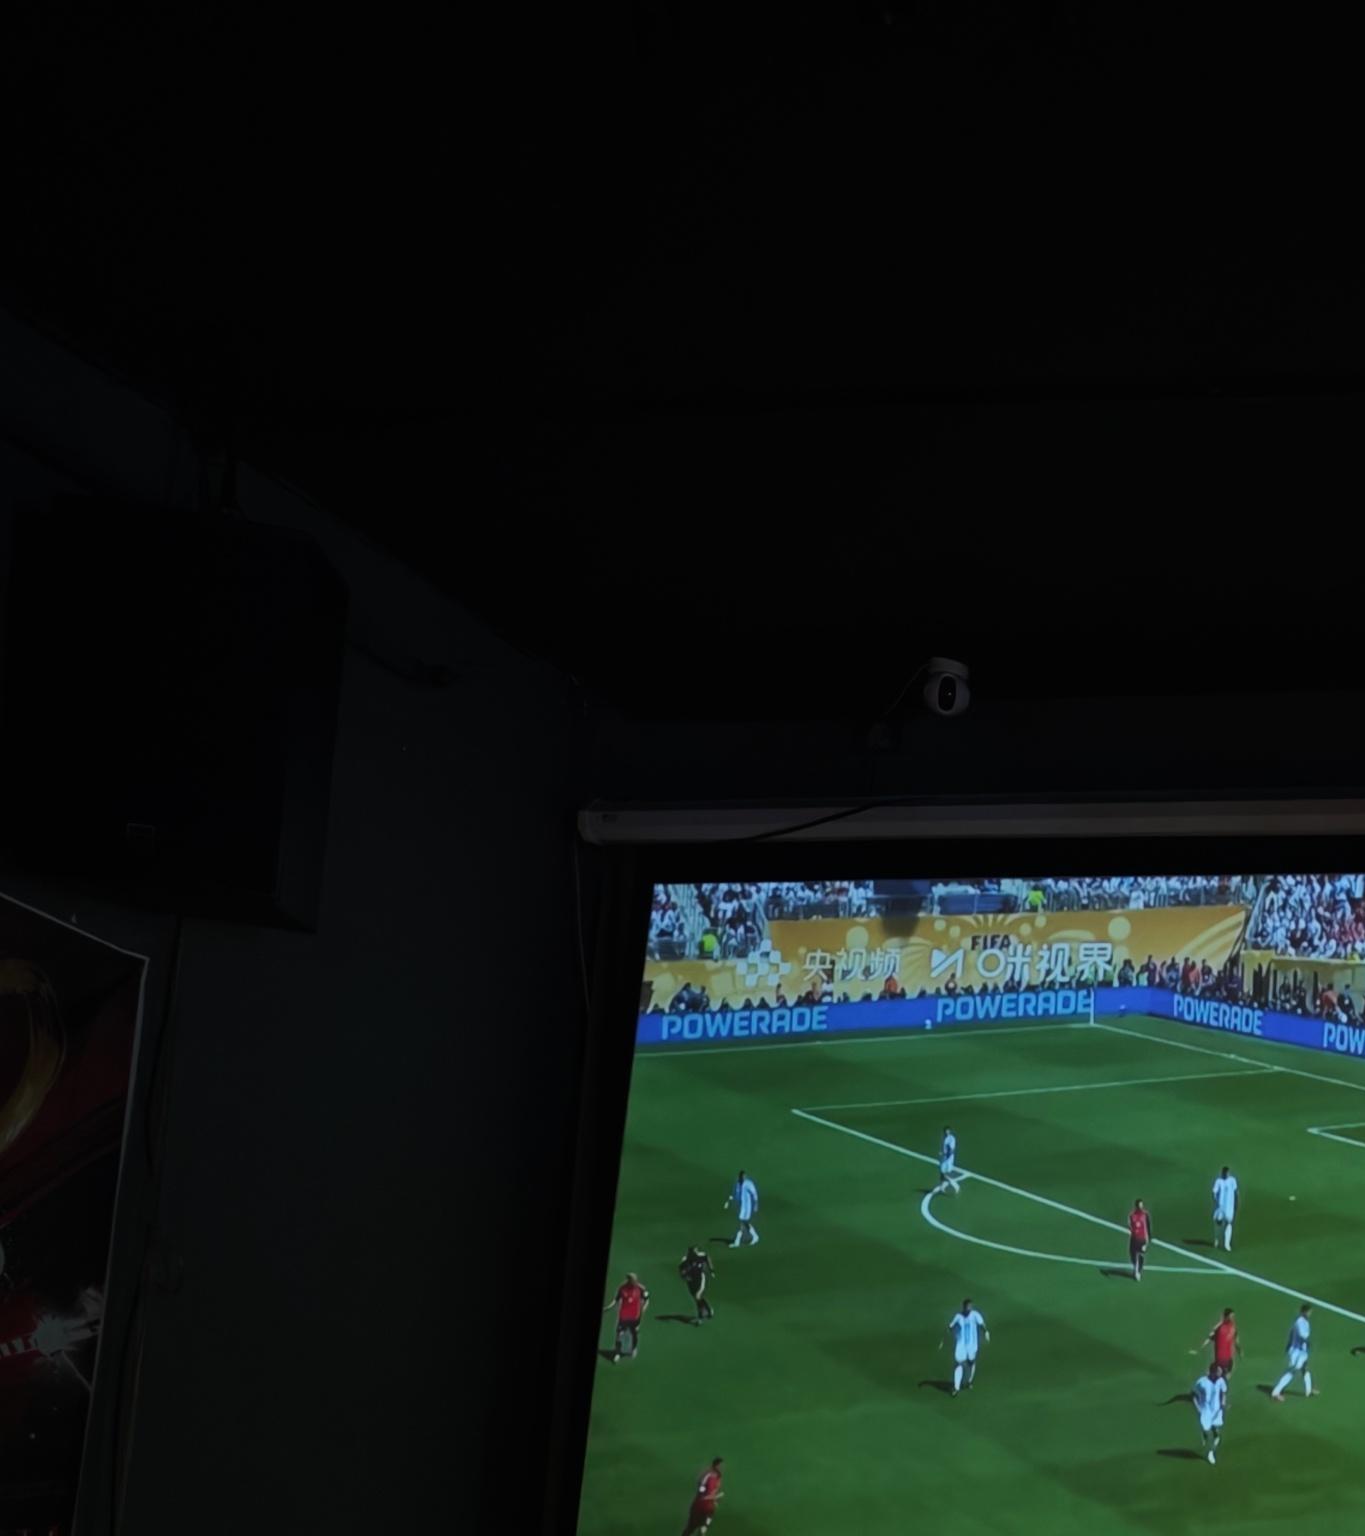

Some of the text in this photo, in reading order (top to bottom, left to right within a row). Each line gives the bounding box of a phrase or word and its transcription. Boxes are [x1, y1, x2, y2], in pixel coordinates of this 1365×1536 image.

[971, 934, 1011, 951] FIFA
[803, 947, 901, 983] 央视频
[662, 1006, 829, 1041] POWERADE
[937, 989, 1091, 1023] POWERADE
[1173, 993, 1264, 1036] POWERADE
